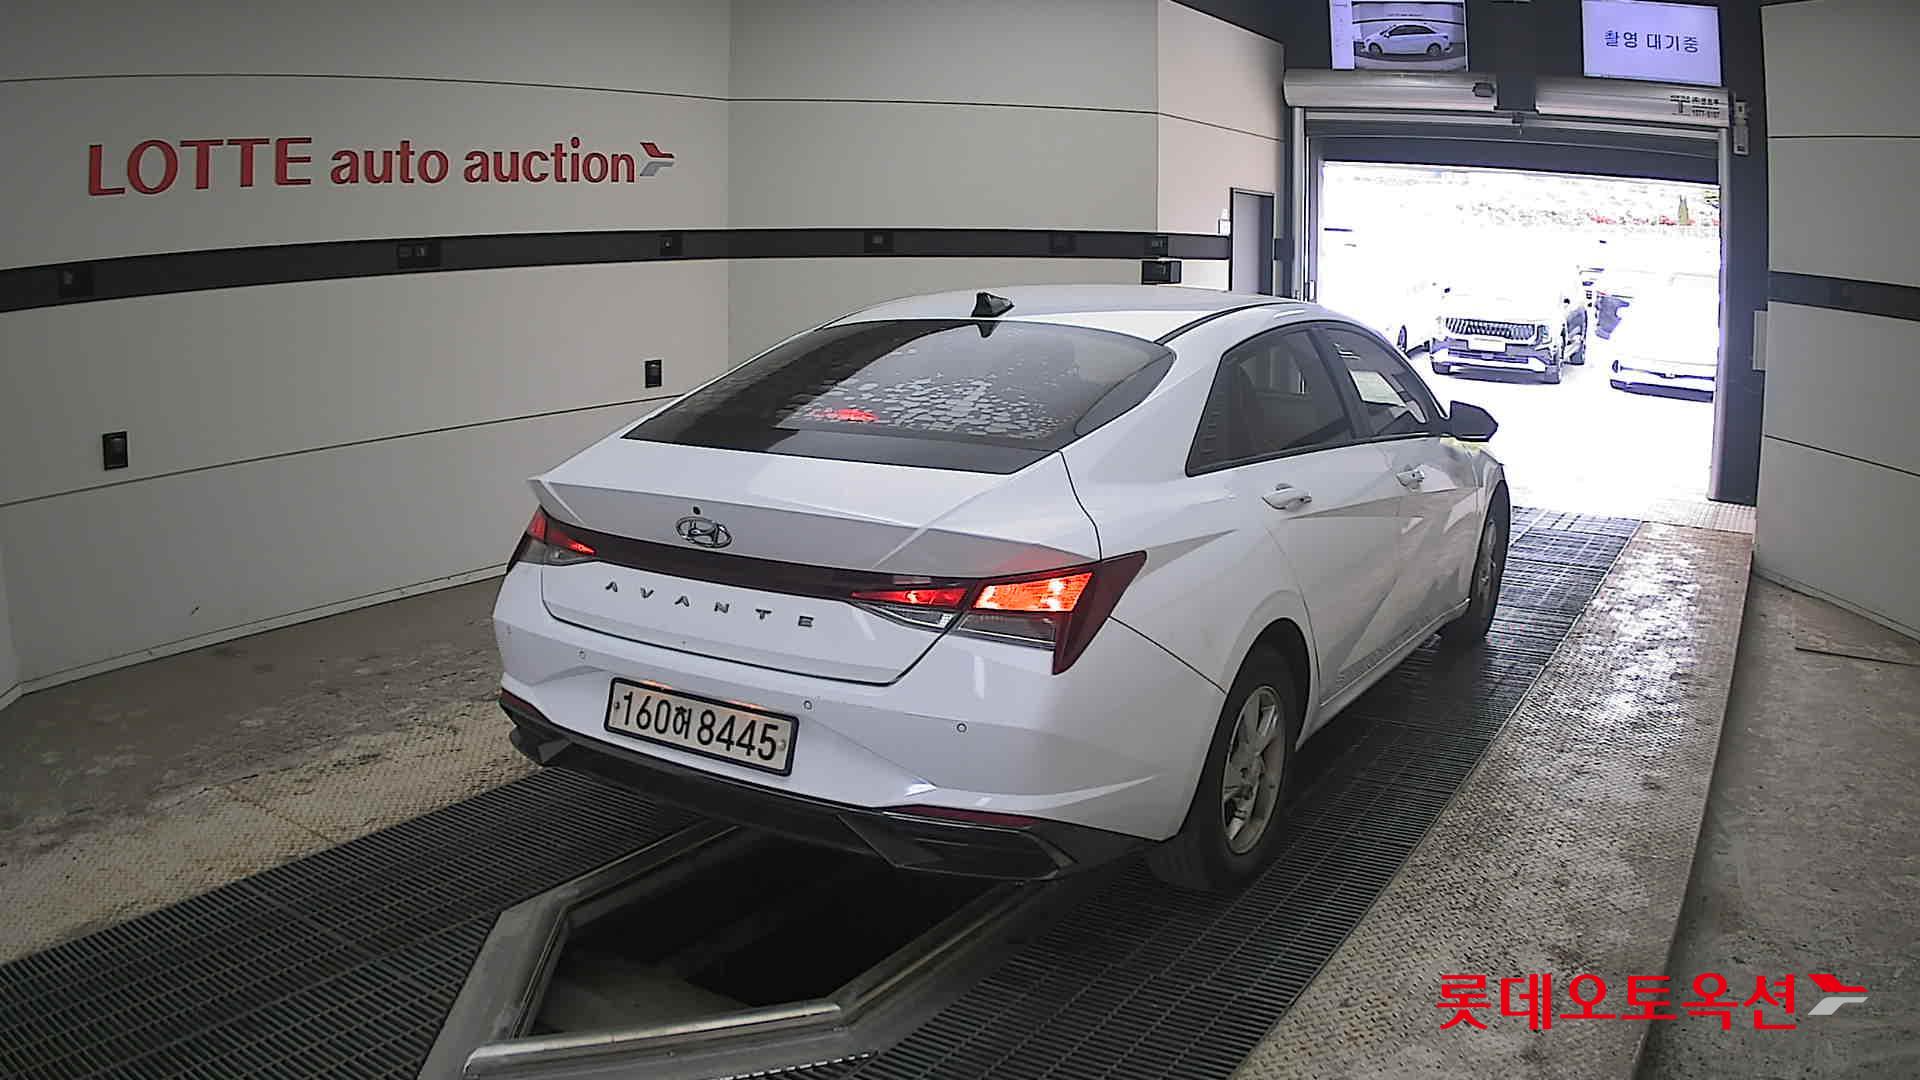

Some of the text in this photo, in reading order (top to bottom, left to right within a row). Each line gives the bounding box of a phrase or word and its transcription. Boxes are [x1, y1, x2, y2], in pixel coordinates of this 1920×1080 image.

[1604, 30, 1698, 53] 촬영 대기중
[88, 136, 635, 196] LOTTE auto auction
[605, 581, 814, 628] AVANTE
